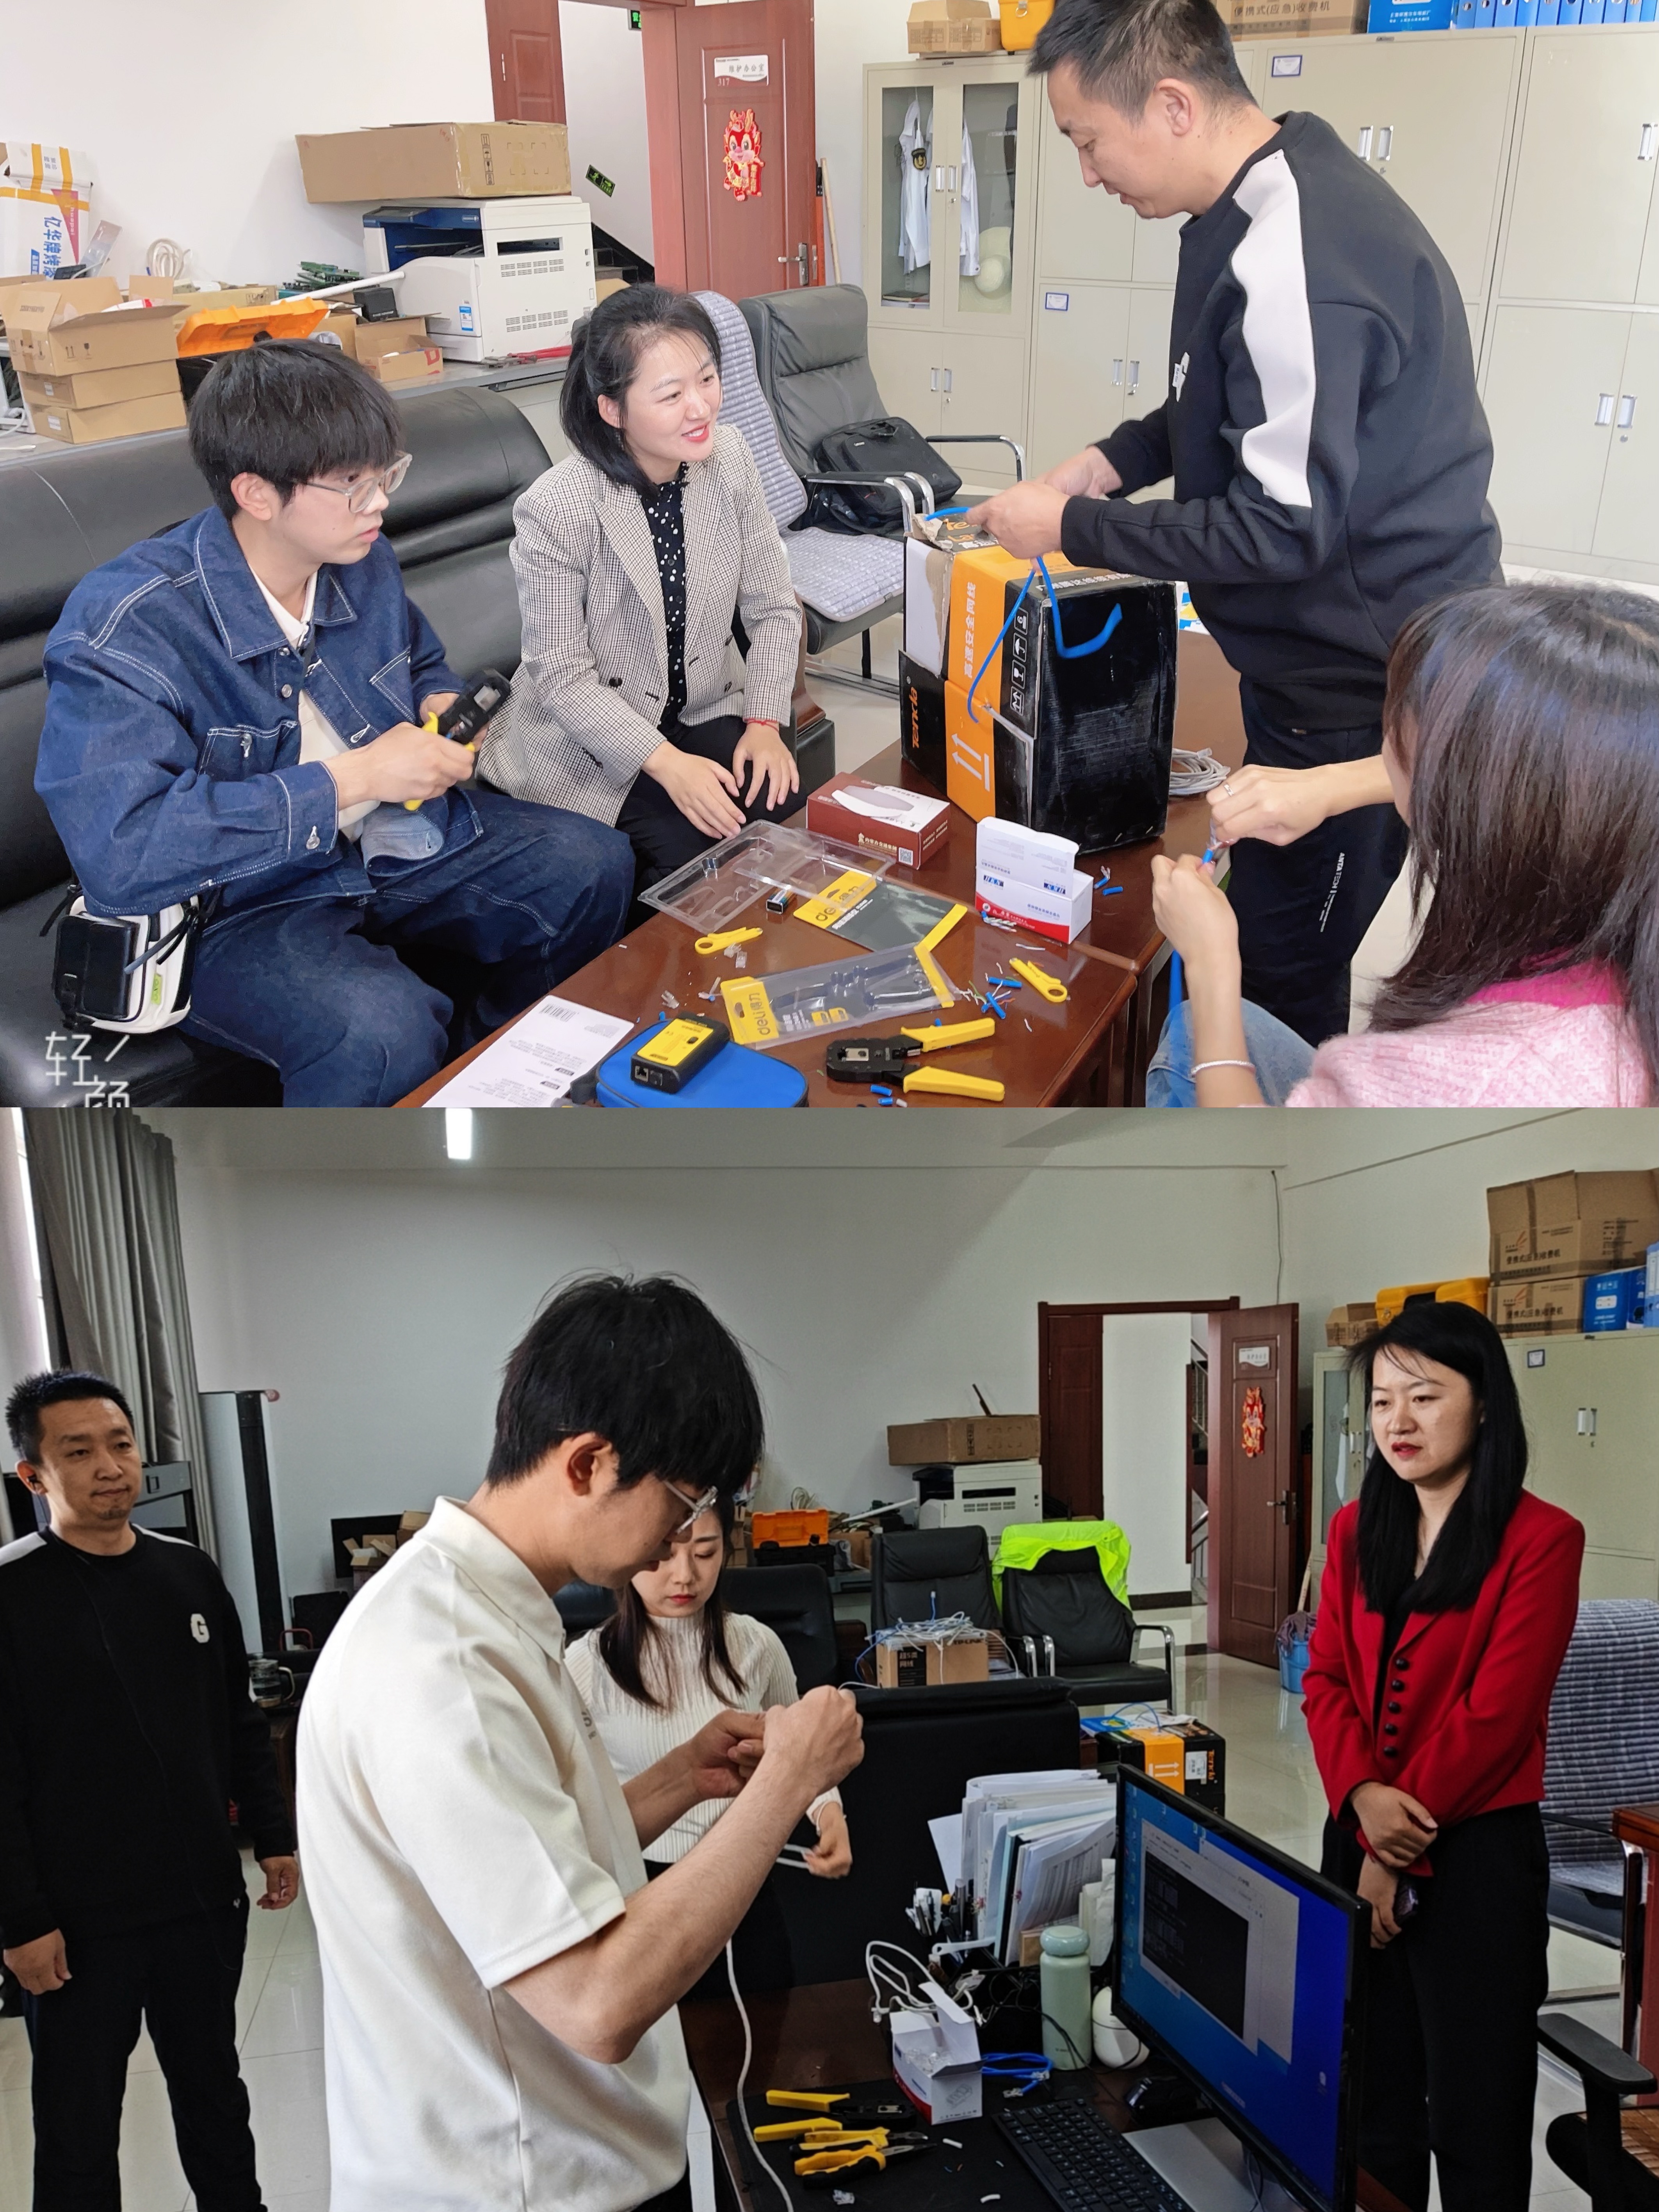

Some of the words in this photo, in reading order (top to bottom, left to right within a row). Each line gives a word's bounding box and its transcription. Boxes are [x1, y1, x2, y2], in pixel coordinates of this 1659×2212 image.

[729, 64, 764, 73] 维护办公室
[964, 582, 976, 678] 高速安全网线
[909, 687, 919, 748] Tenda
